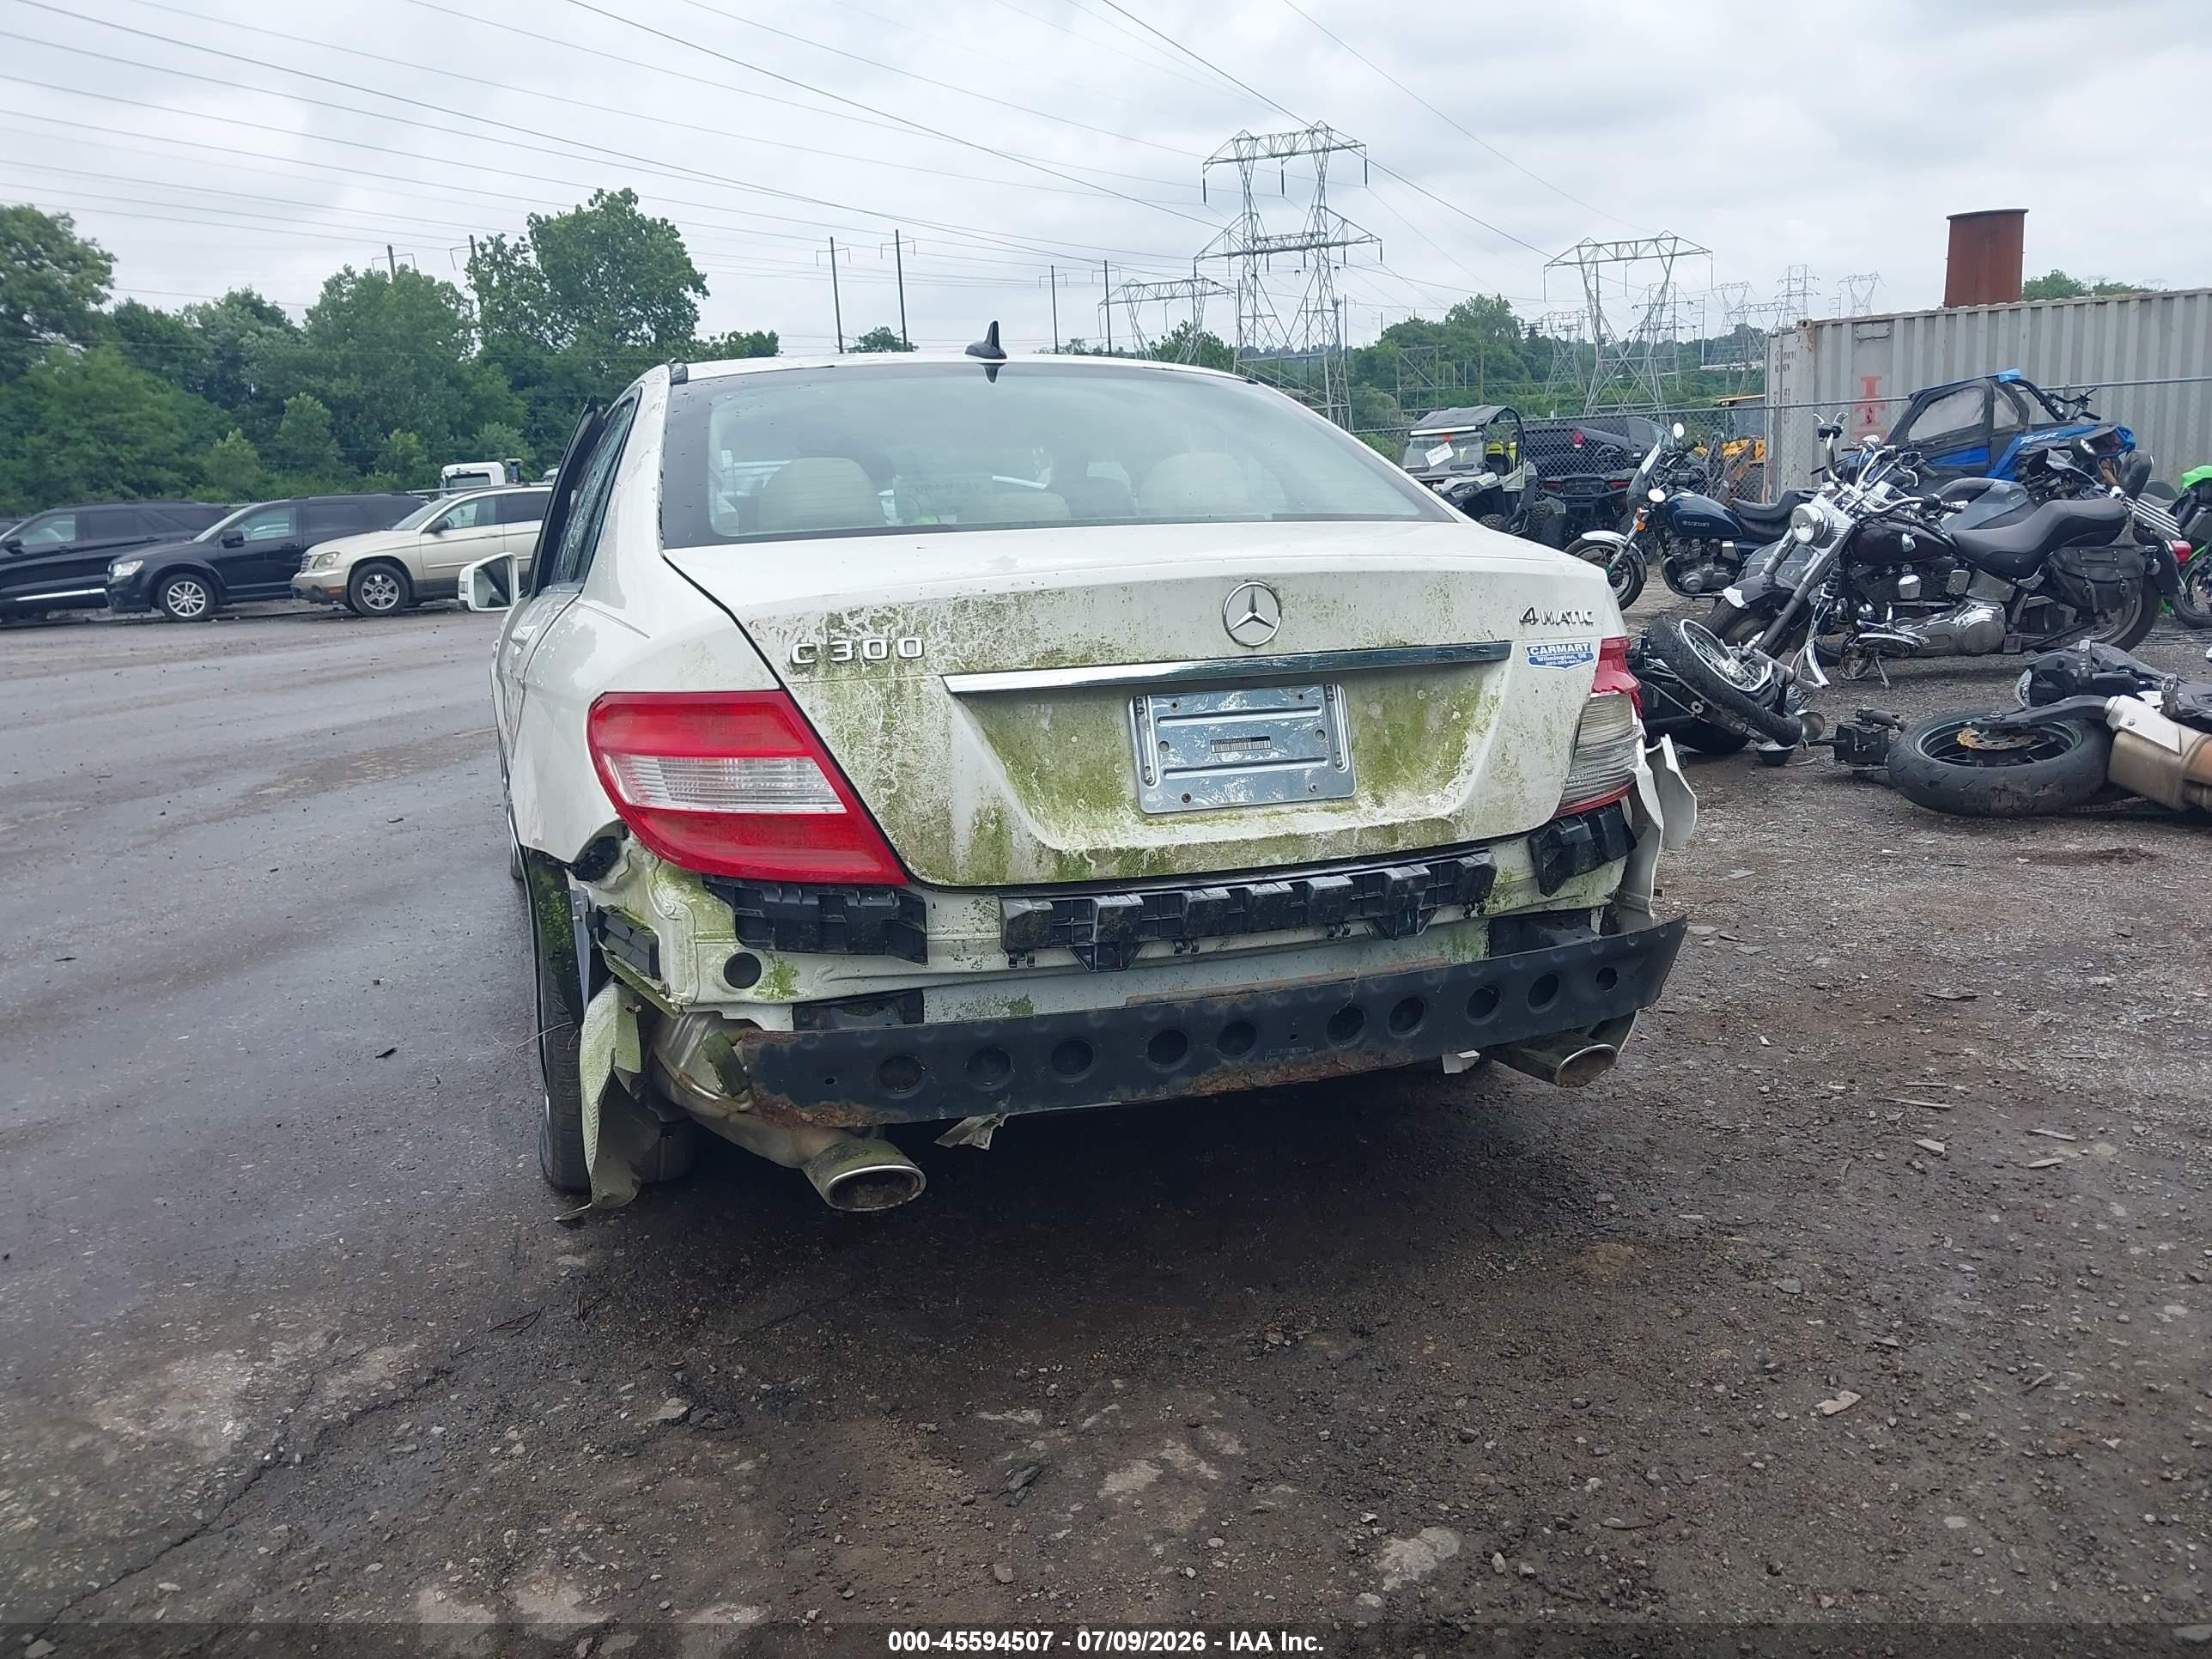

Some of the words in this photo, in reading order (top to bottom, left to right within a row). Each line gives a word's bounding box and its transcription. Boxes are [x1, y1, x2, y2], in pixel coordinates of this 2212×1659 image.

[1518, 606, 1595, 626] 4MATIC
[791, 643, 817, 664] C
[830, 637, 923, 662] 300
[1529, 643, 1589, 655] CARMART
